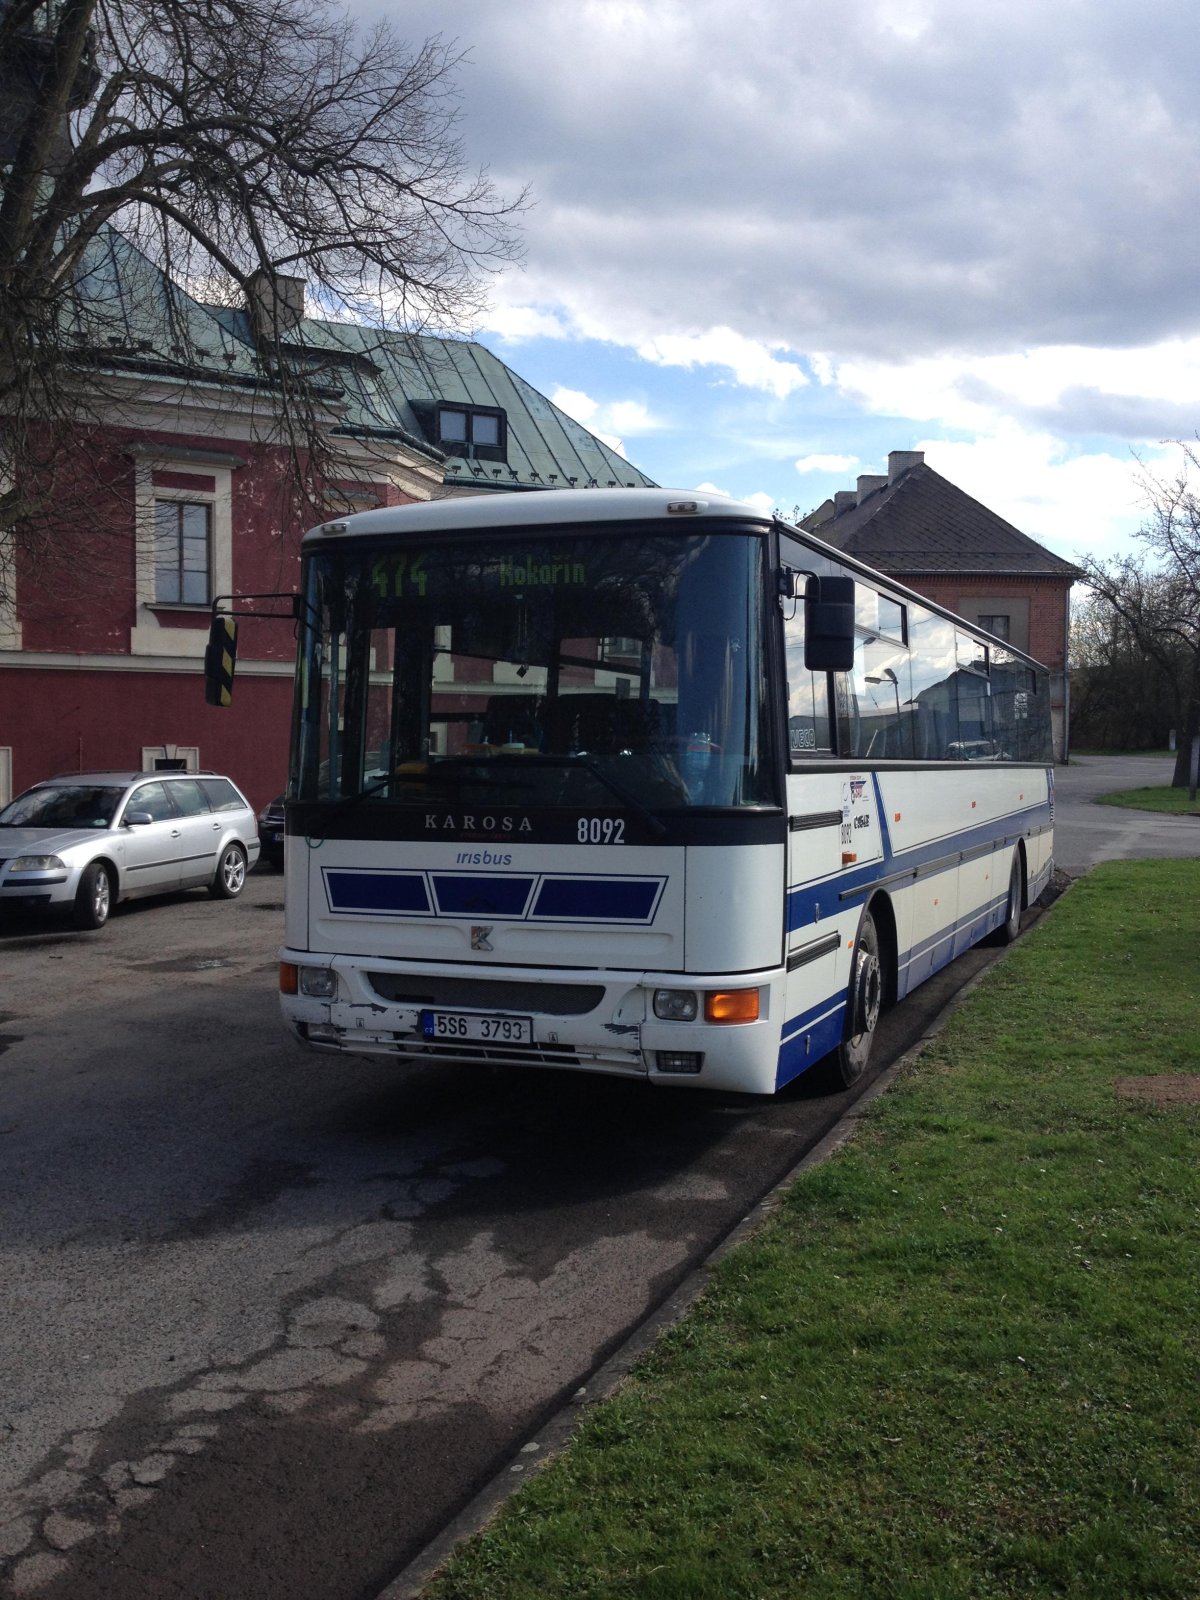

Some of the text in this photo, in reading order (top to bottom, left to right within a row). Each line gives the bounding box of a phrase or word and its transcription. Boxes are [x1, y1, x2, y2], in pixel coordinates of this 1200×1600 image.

[371, 551, 428, 598] 474
[424, 814, 533, 832] KAROSA
[577, 817, 625, 844] 8092
[456, 850, 512, 866] irisbus
[437, 1015, 523, 1041] 5S6 3793
